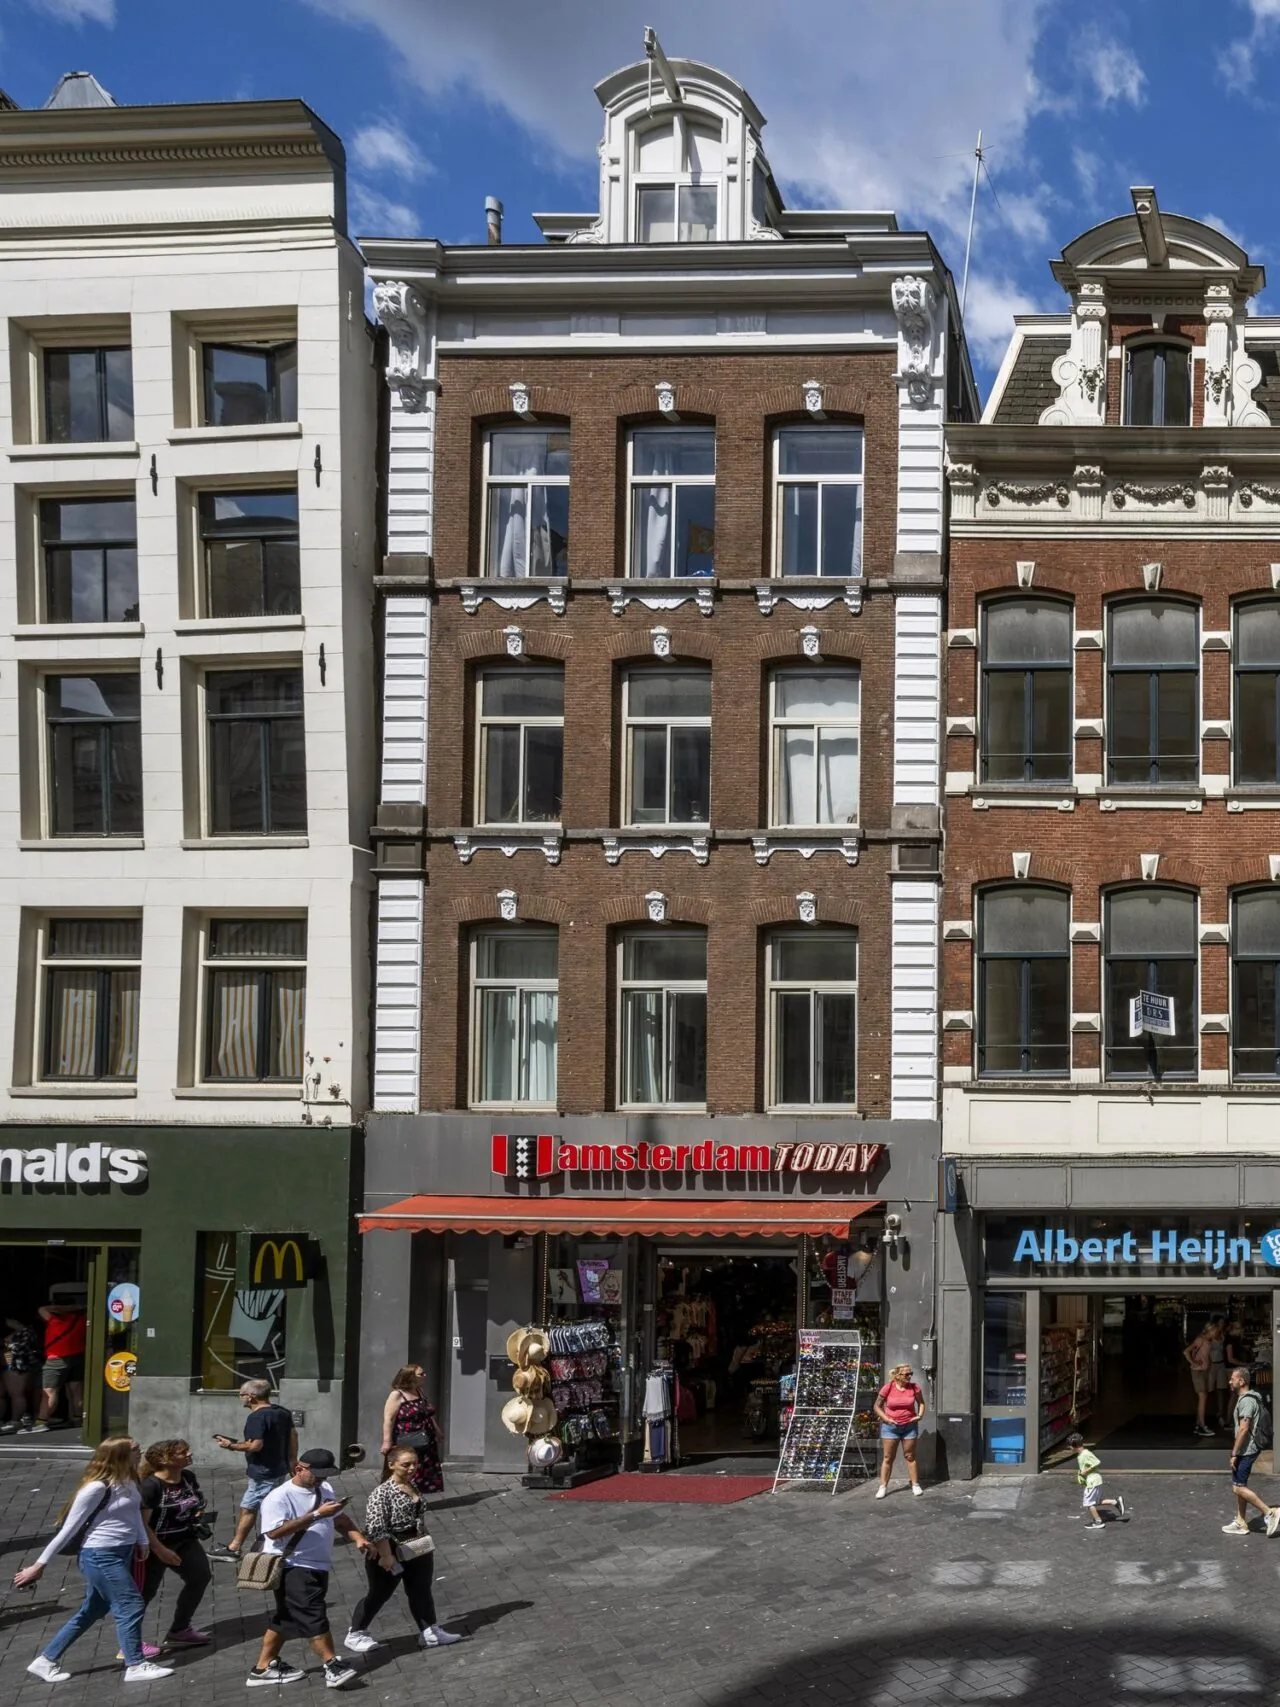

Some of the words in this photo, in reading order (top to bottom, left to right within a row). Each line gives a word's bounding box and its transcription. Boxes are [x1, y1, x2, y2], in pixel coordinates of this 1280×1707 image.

[557, 1140, 770, 1172] amsterdam
[772, 1142, 881, 1172] TODAY
[1013, 1229, 1137, 1262] Albert
[1151, 1230, 1250, 1270] Heijn
